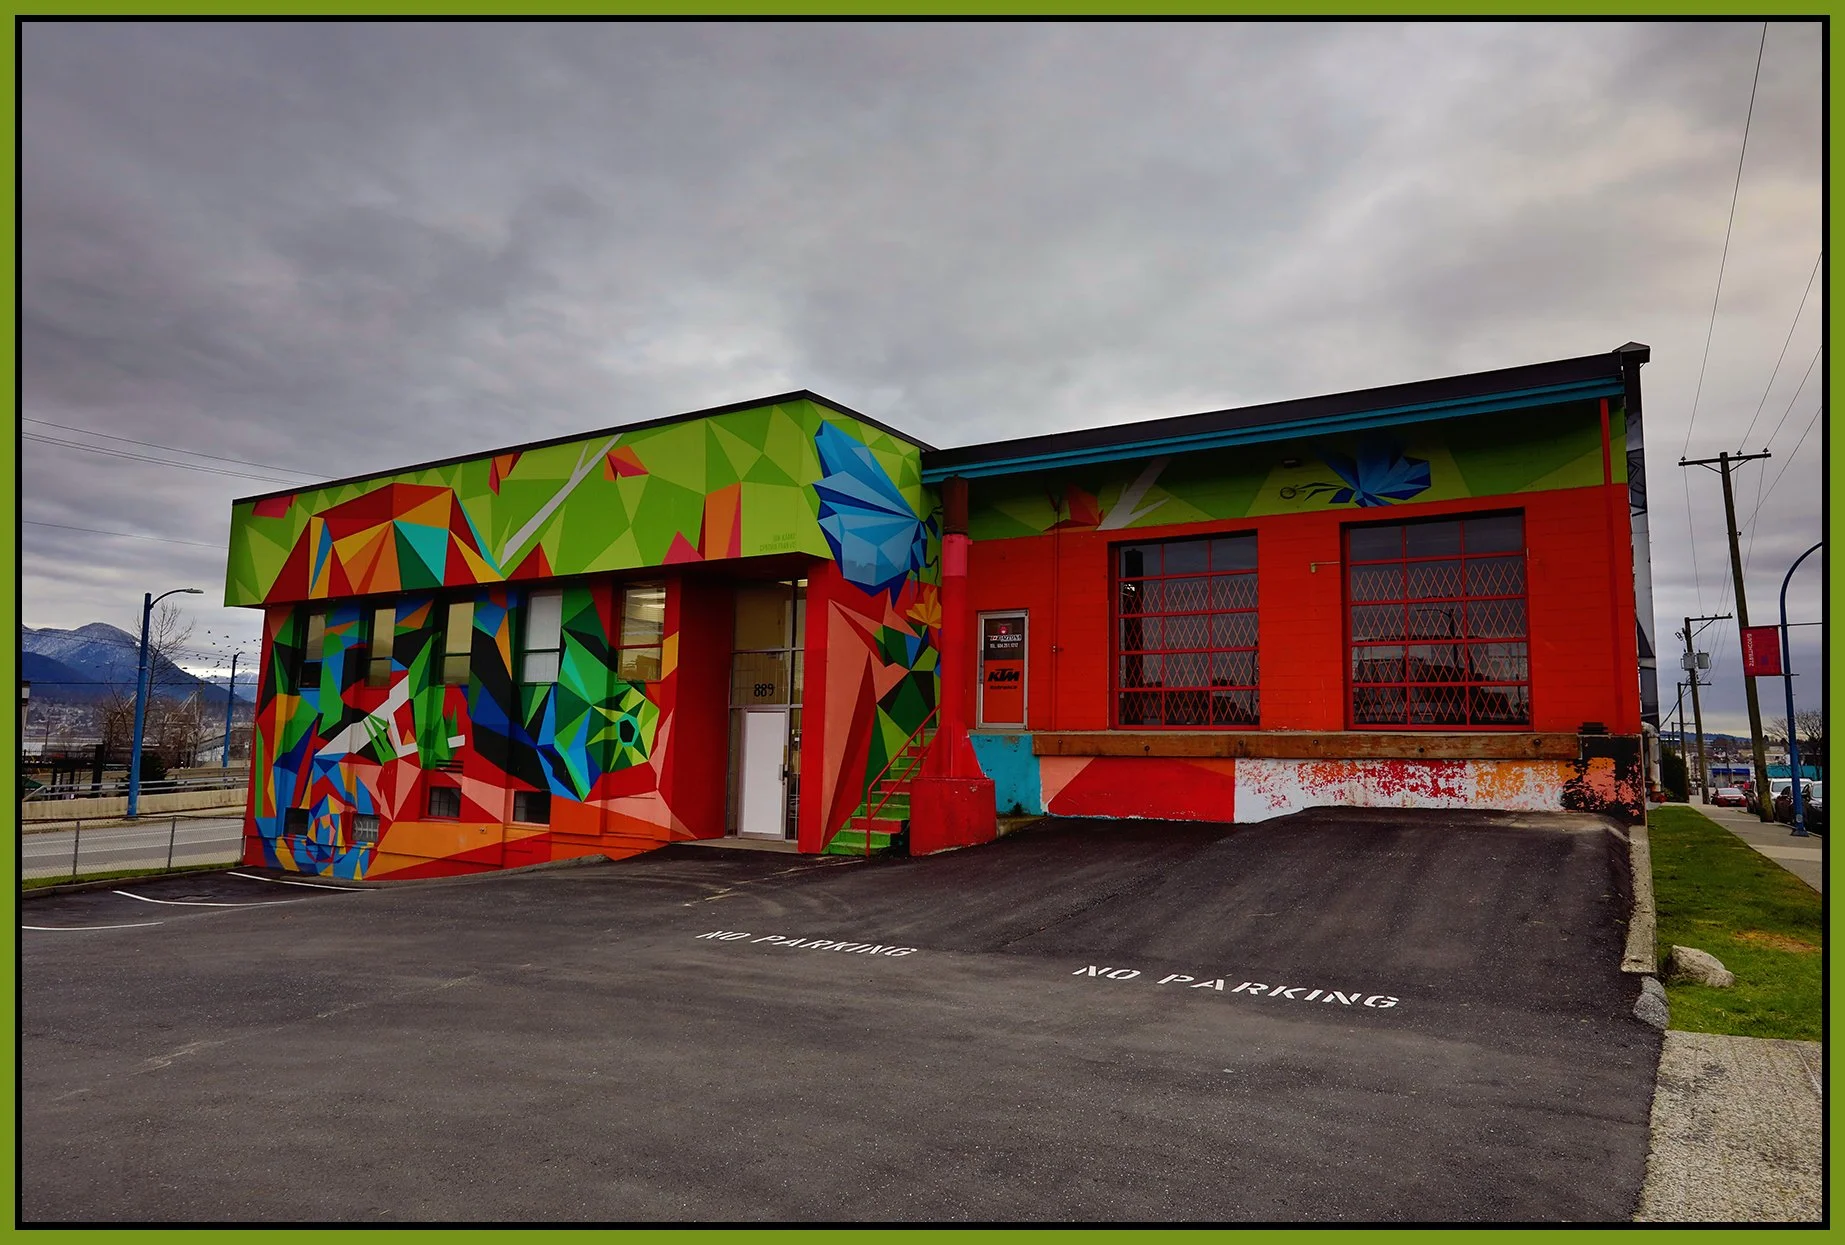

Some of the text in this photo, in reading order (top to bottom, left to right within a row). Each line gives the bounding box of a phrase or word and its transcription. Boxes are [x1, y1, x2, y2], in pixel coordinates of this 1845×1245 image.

[988, 668, 1020, 682] KTM
[754, 683, 775, 697] 889
[696, 930, 918, 957] NO PARKING
[1072, 965, 1400, 1008] NO PARKING
